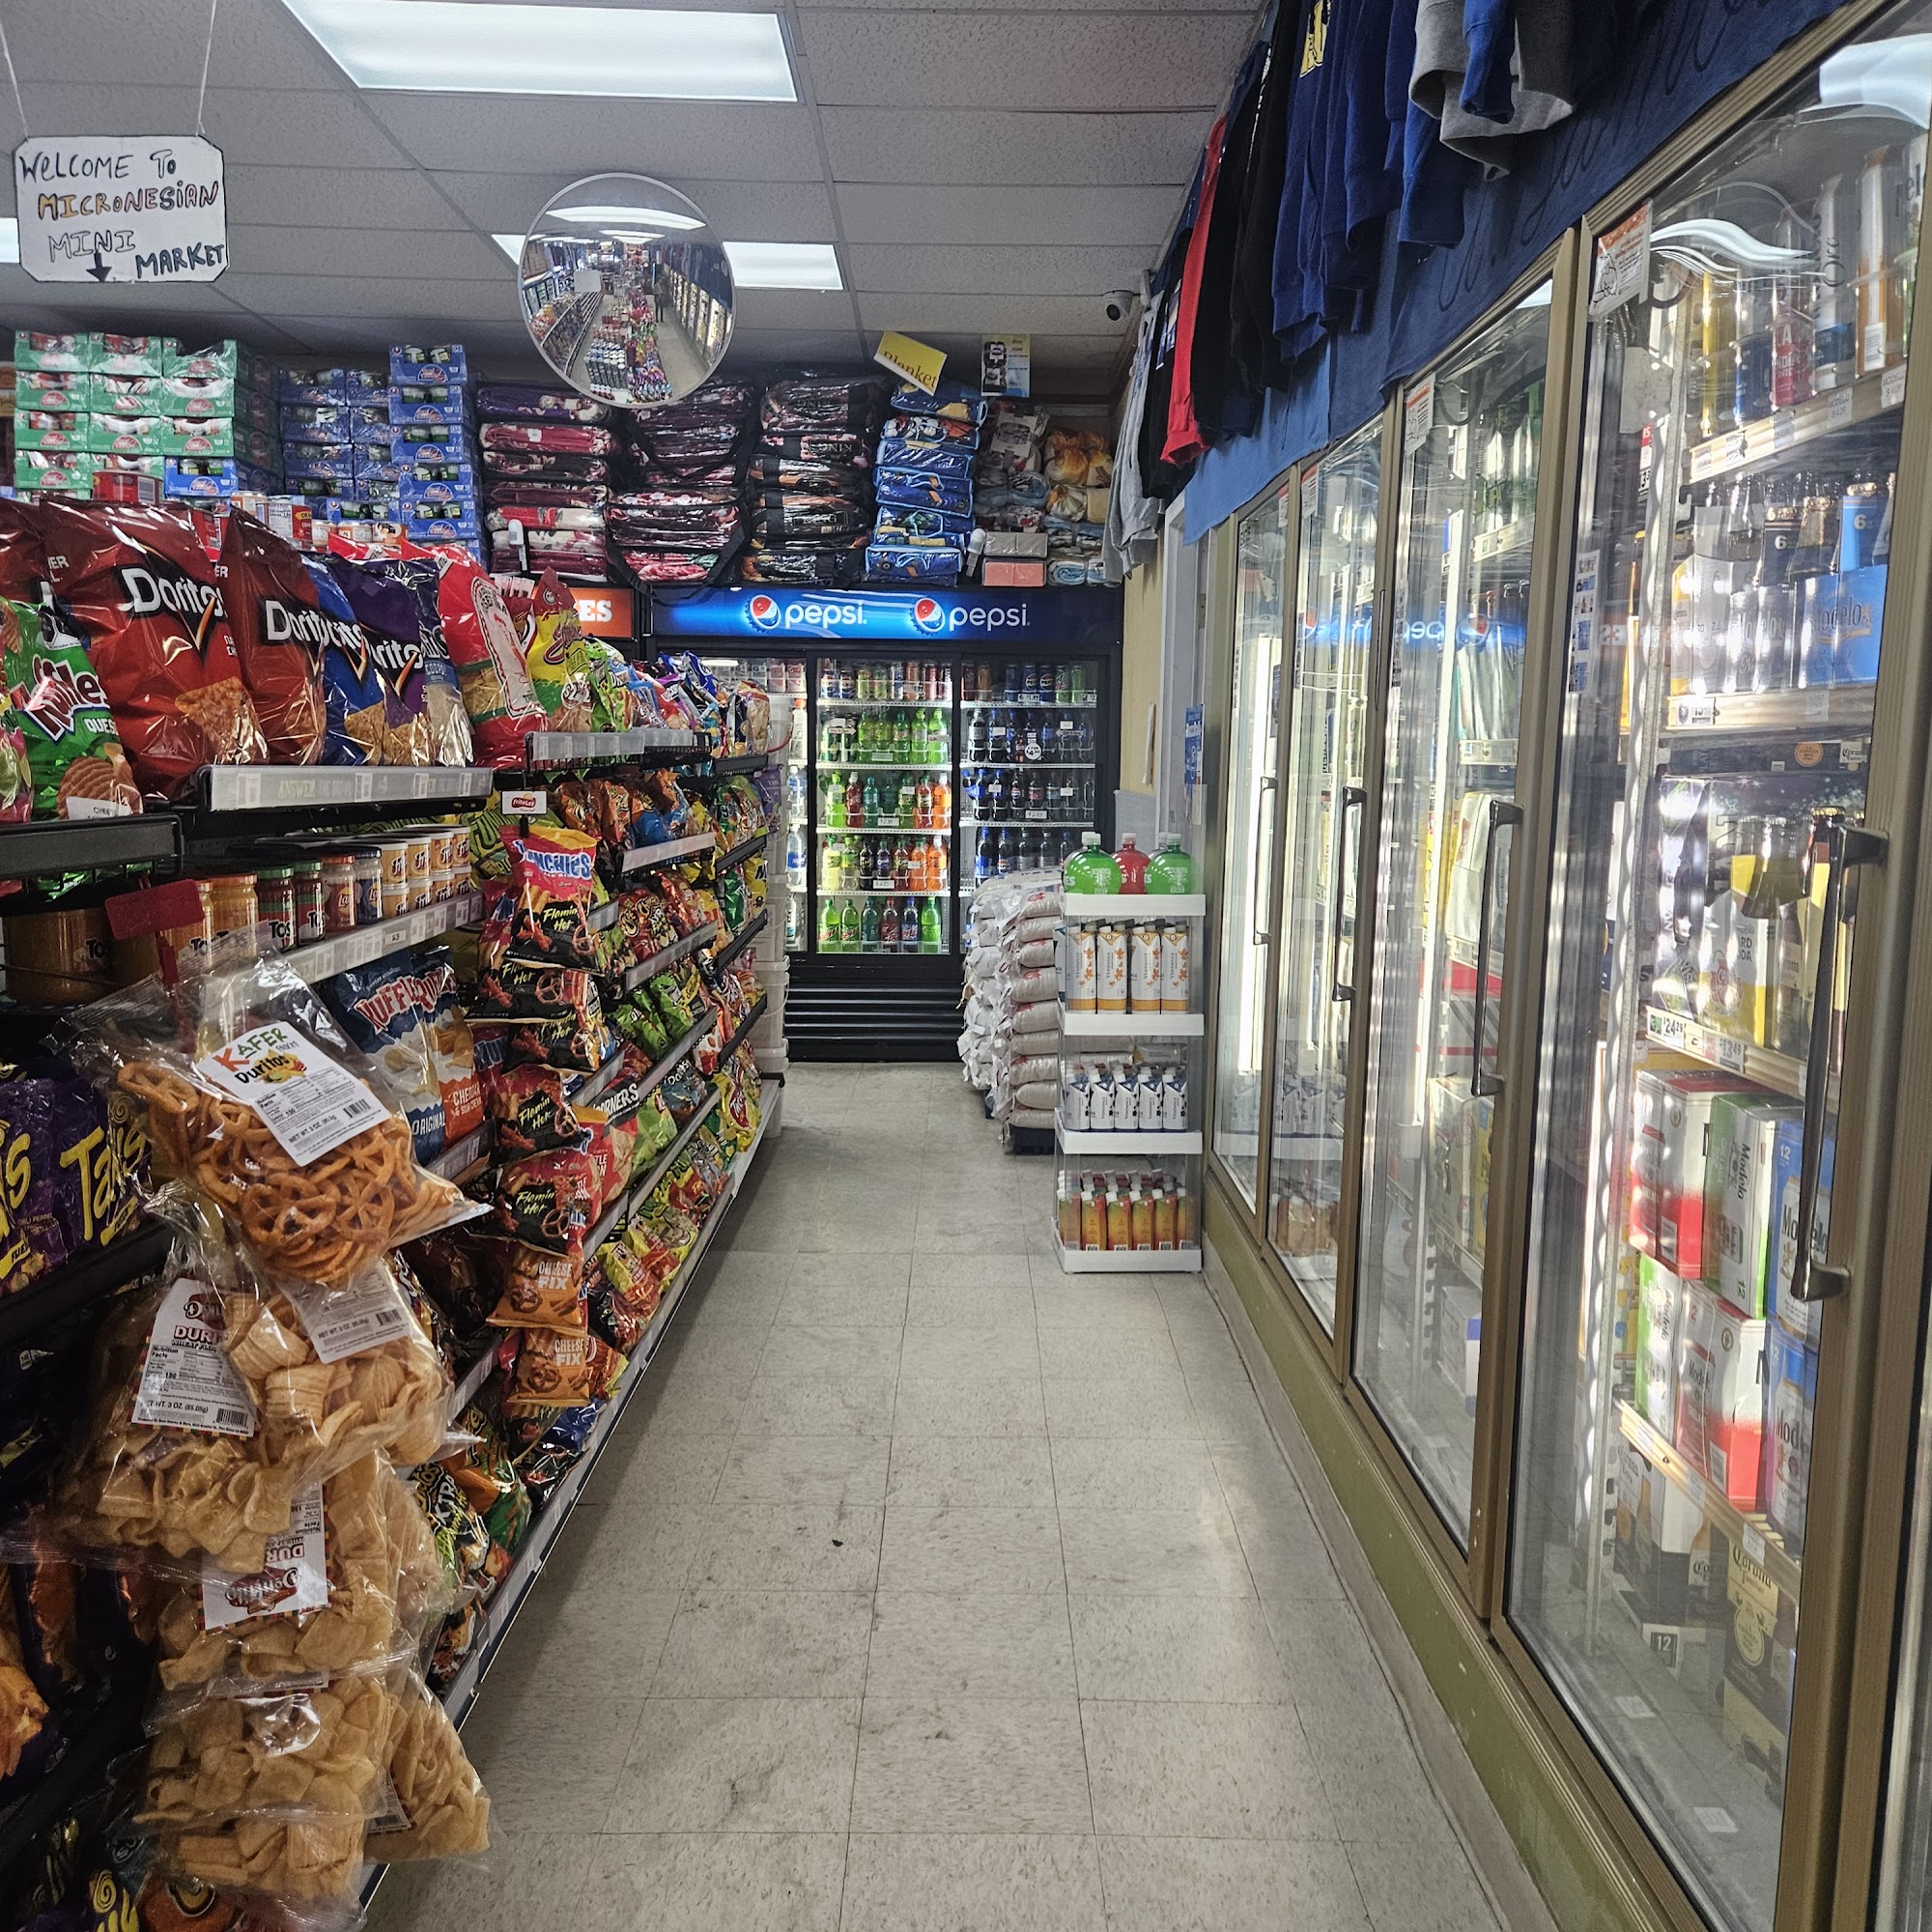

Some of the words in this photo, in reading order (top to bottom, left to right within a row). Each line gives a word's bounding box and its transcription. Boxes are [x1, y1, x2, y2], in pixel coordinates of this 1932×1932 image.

[48, 230, 136, 263] MINI
[135, 242, 226, 278] MARKET
[1854, 513, 1868, 530] 6
[1774, 534, 1787, 551] 6
[265, 600, 328, 644] Dorit
[783, 600, 864, 630] pepsi
[948, 602, 1028, 631] pepsi
[213, 1027, 289, 1073] KAFER
[234, 1055, 291, 1084] Duritos
[411, 1113, 446, 1136] ORIGINAL
[1779, 1145, 1791, 1161] 12
[1737, 1143, 1752, 1201] Modelo
[538, 1261, 573, 1276] CHEESE
[537, 1277, 569, 1291] FIX
[1738, 1279, 1747, 1300] 12
[554, 1338, 584, 1352] CHEESE
[555, 1354, 582, 1367] FIX
[173, 1401, 184, 1410] OZ.
[1656, 1634, 1671, 1653] 12
